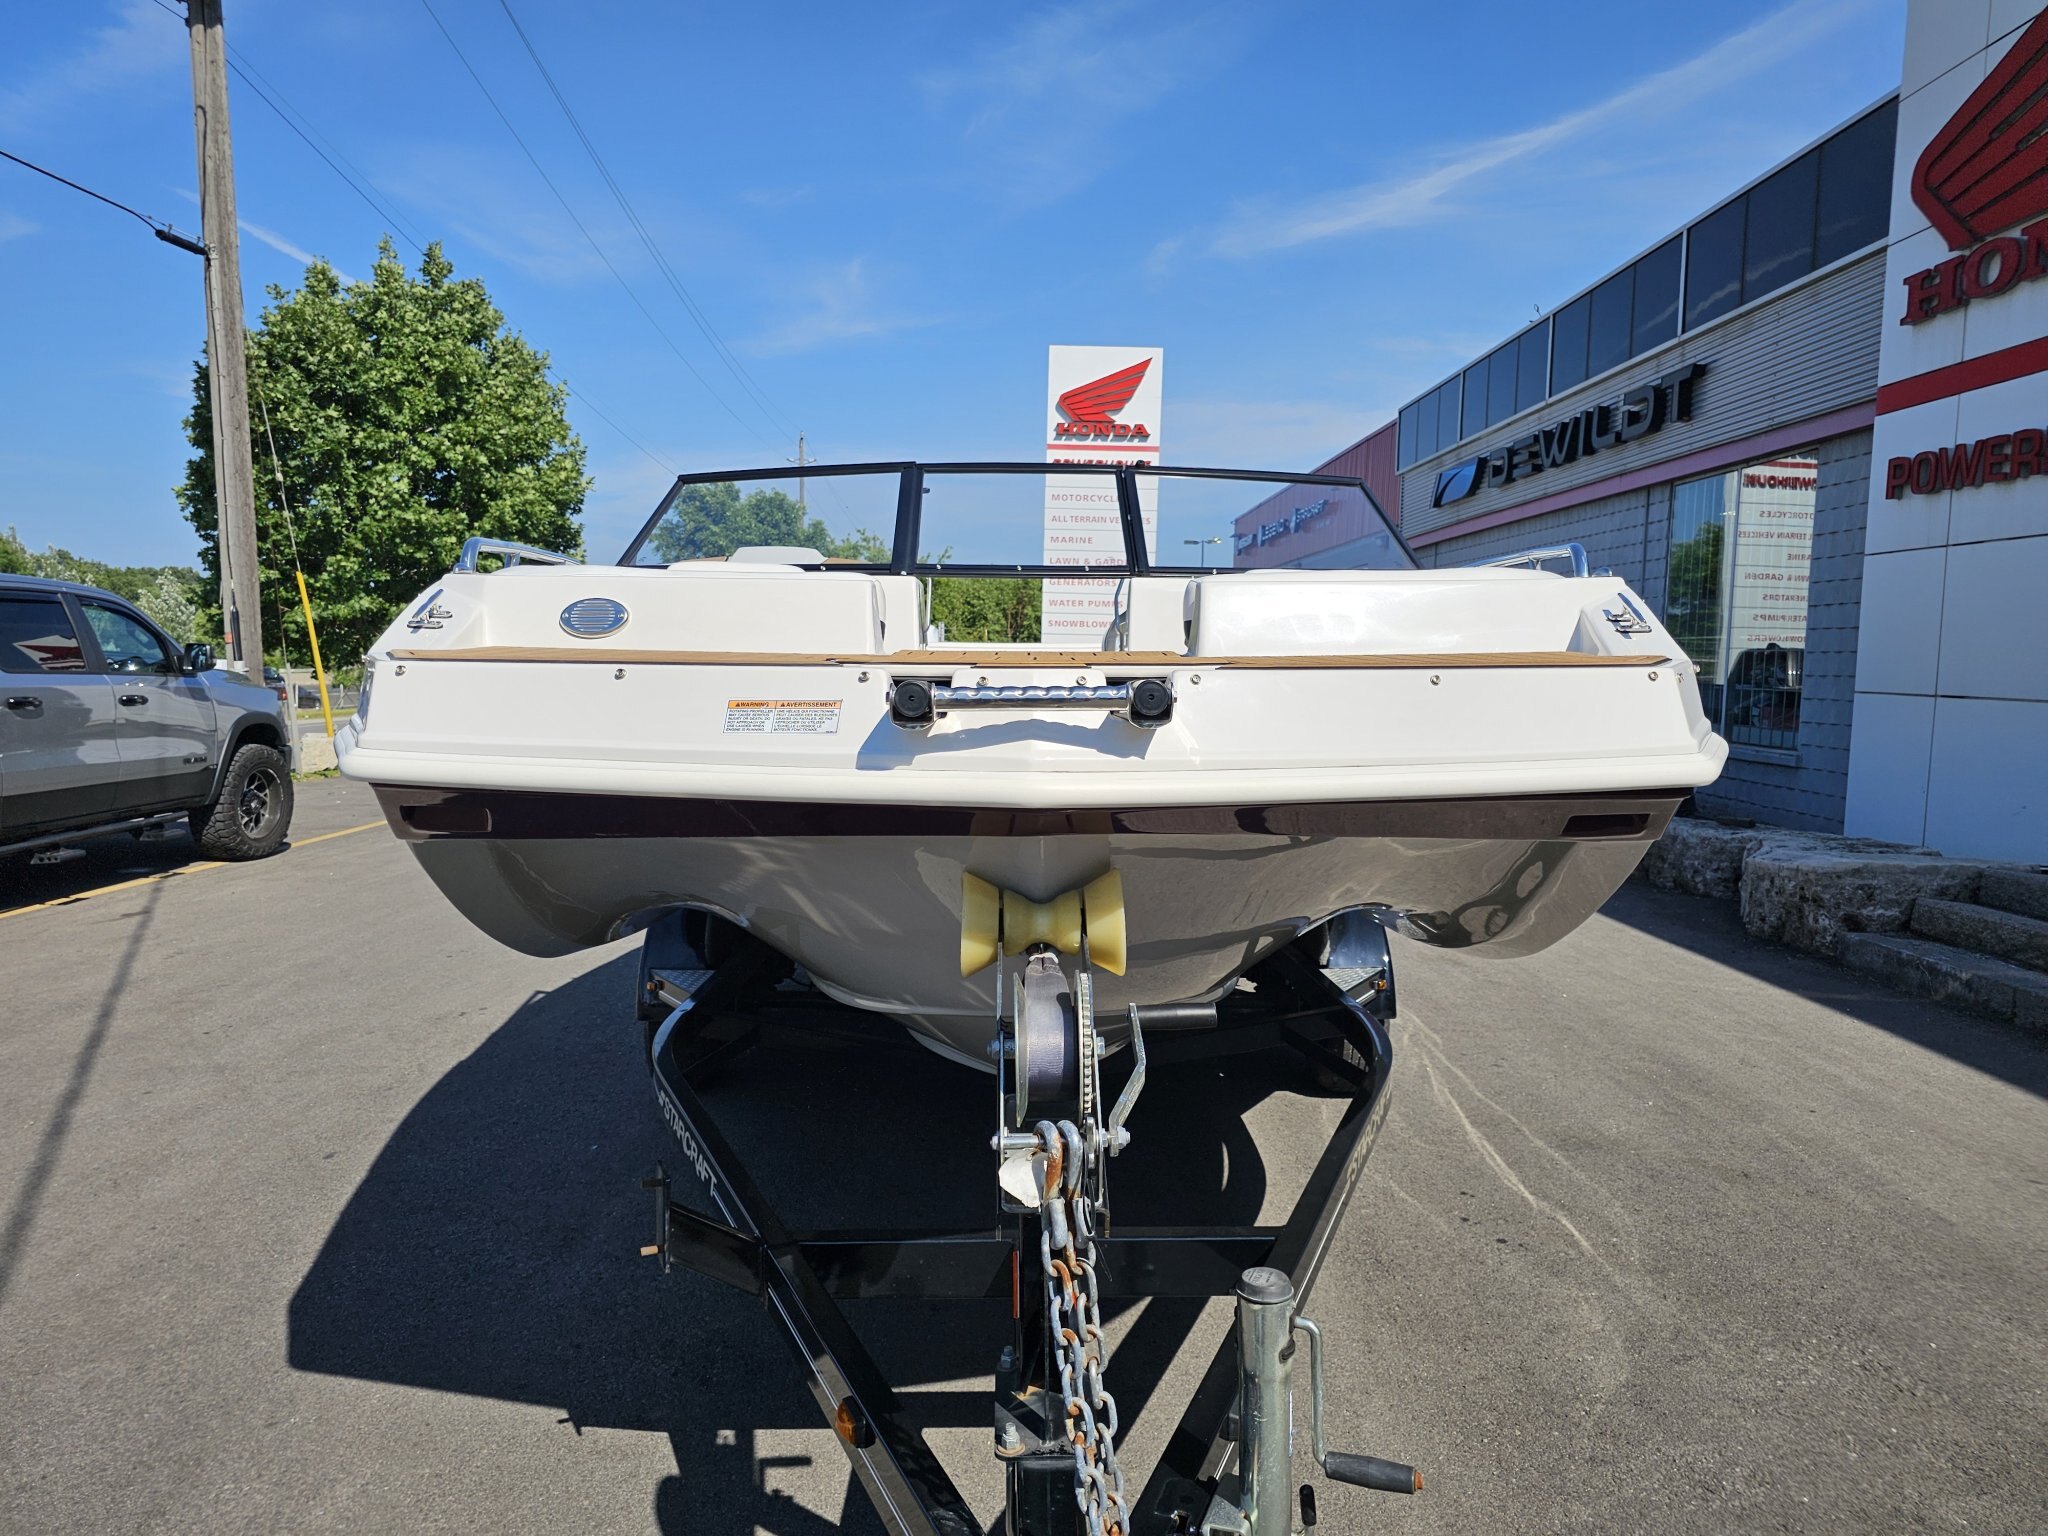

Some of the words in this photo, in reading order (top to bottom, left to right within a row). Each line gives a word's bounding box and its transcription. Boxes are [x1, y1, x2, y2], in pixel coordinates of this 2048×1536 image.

[1056, 423, 1150, 438] HONDA
[1487, 364, 1704, 488] DEWILDT
[1886, 428, 2048, 500] POWER
[1051, 493, 1120, 502] MOTORCYCL
[1051, 515, 1068, 523] ALL
[1070, 515, 1107, 524] TERRAIN
[1050, 536, 1093, 544] MARINE
[1049, 557, 1080, 565] LAWN
[1095, 558, 1126, 566] GARD
[1049, 577, 1117, 587] GENERATORS
[1049, 599, 1084, 607] WATER
[1048, 620, 1112, 628] SNOWBLOW
[664, 1097, 717, 1197] STARCRAFT
